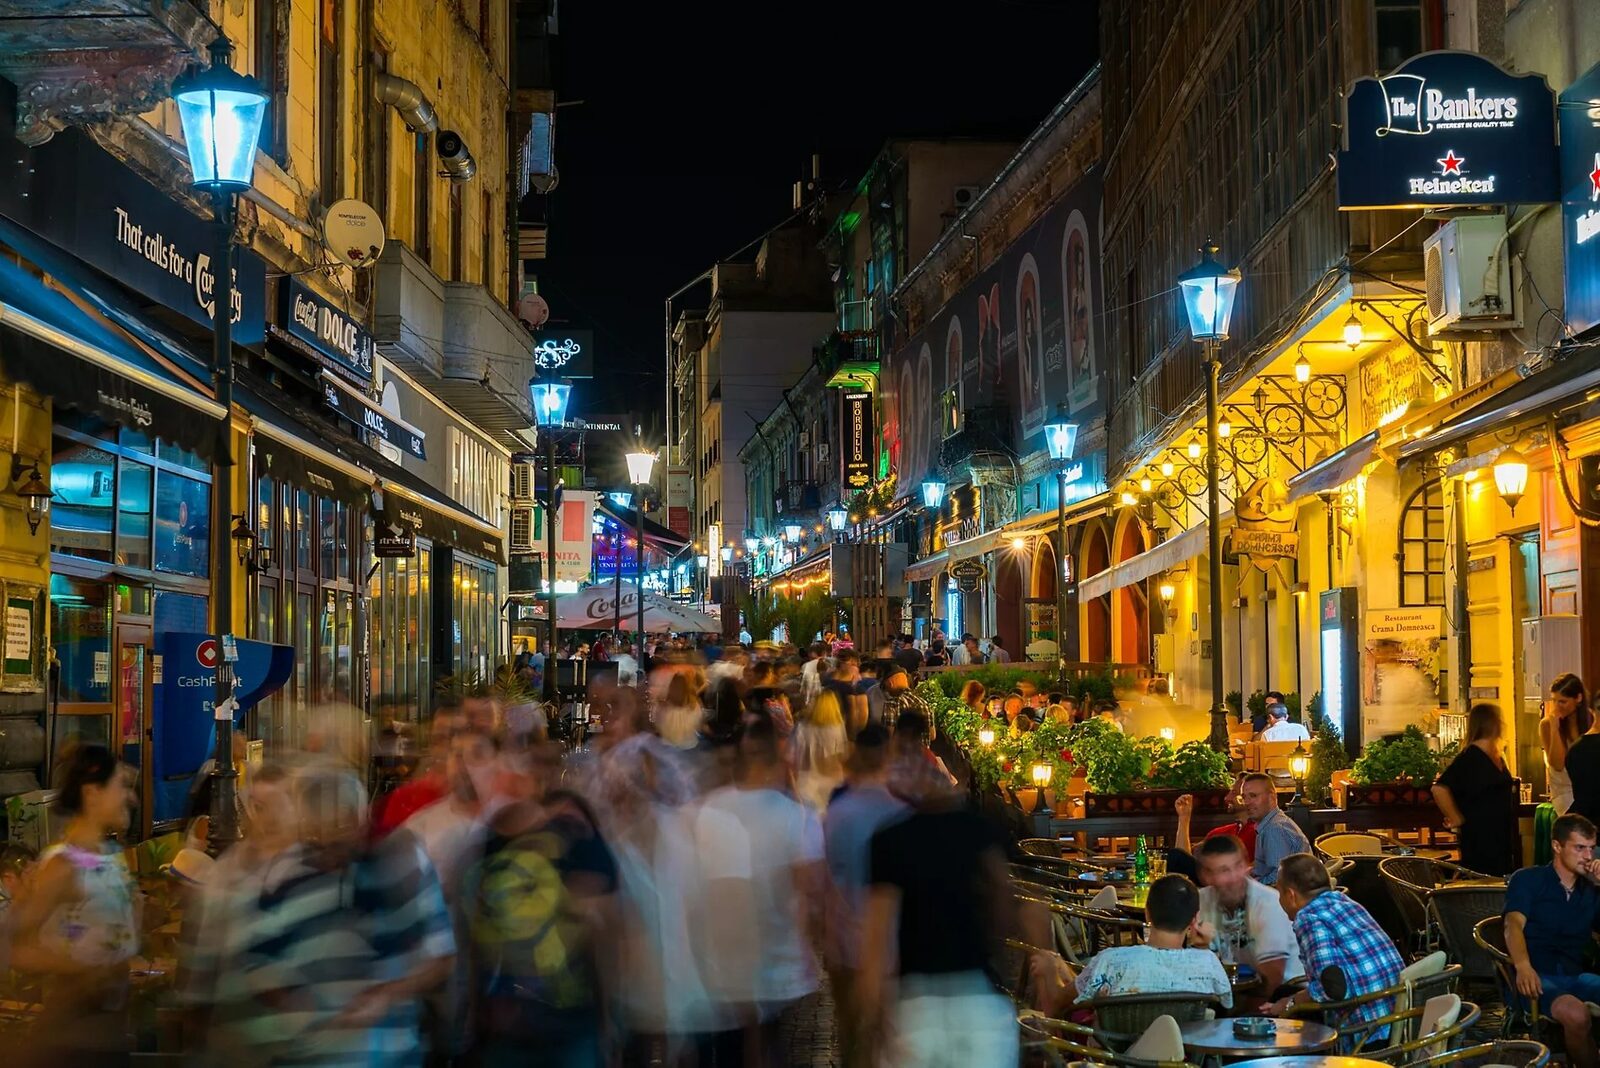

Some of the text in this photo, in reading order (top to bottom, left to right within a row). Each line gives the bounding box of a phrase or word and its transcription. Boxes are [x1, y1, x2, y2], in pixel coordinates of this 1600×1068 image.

[1391, 88, 1518, 121] The Bankers
[1409, 177, 1494, 194] Heineken
[114, 206, 142, 254] That
[144, 233, 168, 269] calls
[169, 243, 184, 278] for
[186, 261, 193, 284] a
[323, 307, 358, 358] DOLCE
[364, 407, 384, 435] DOLCE
[1371, 623, 1435, 633] Crama Domneasca
[1384, 614, 1422, 622] Restaurant
